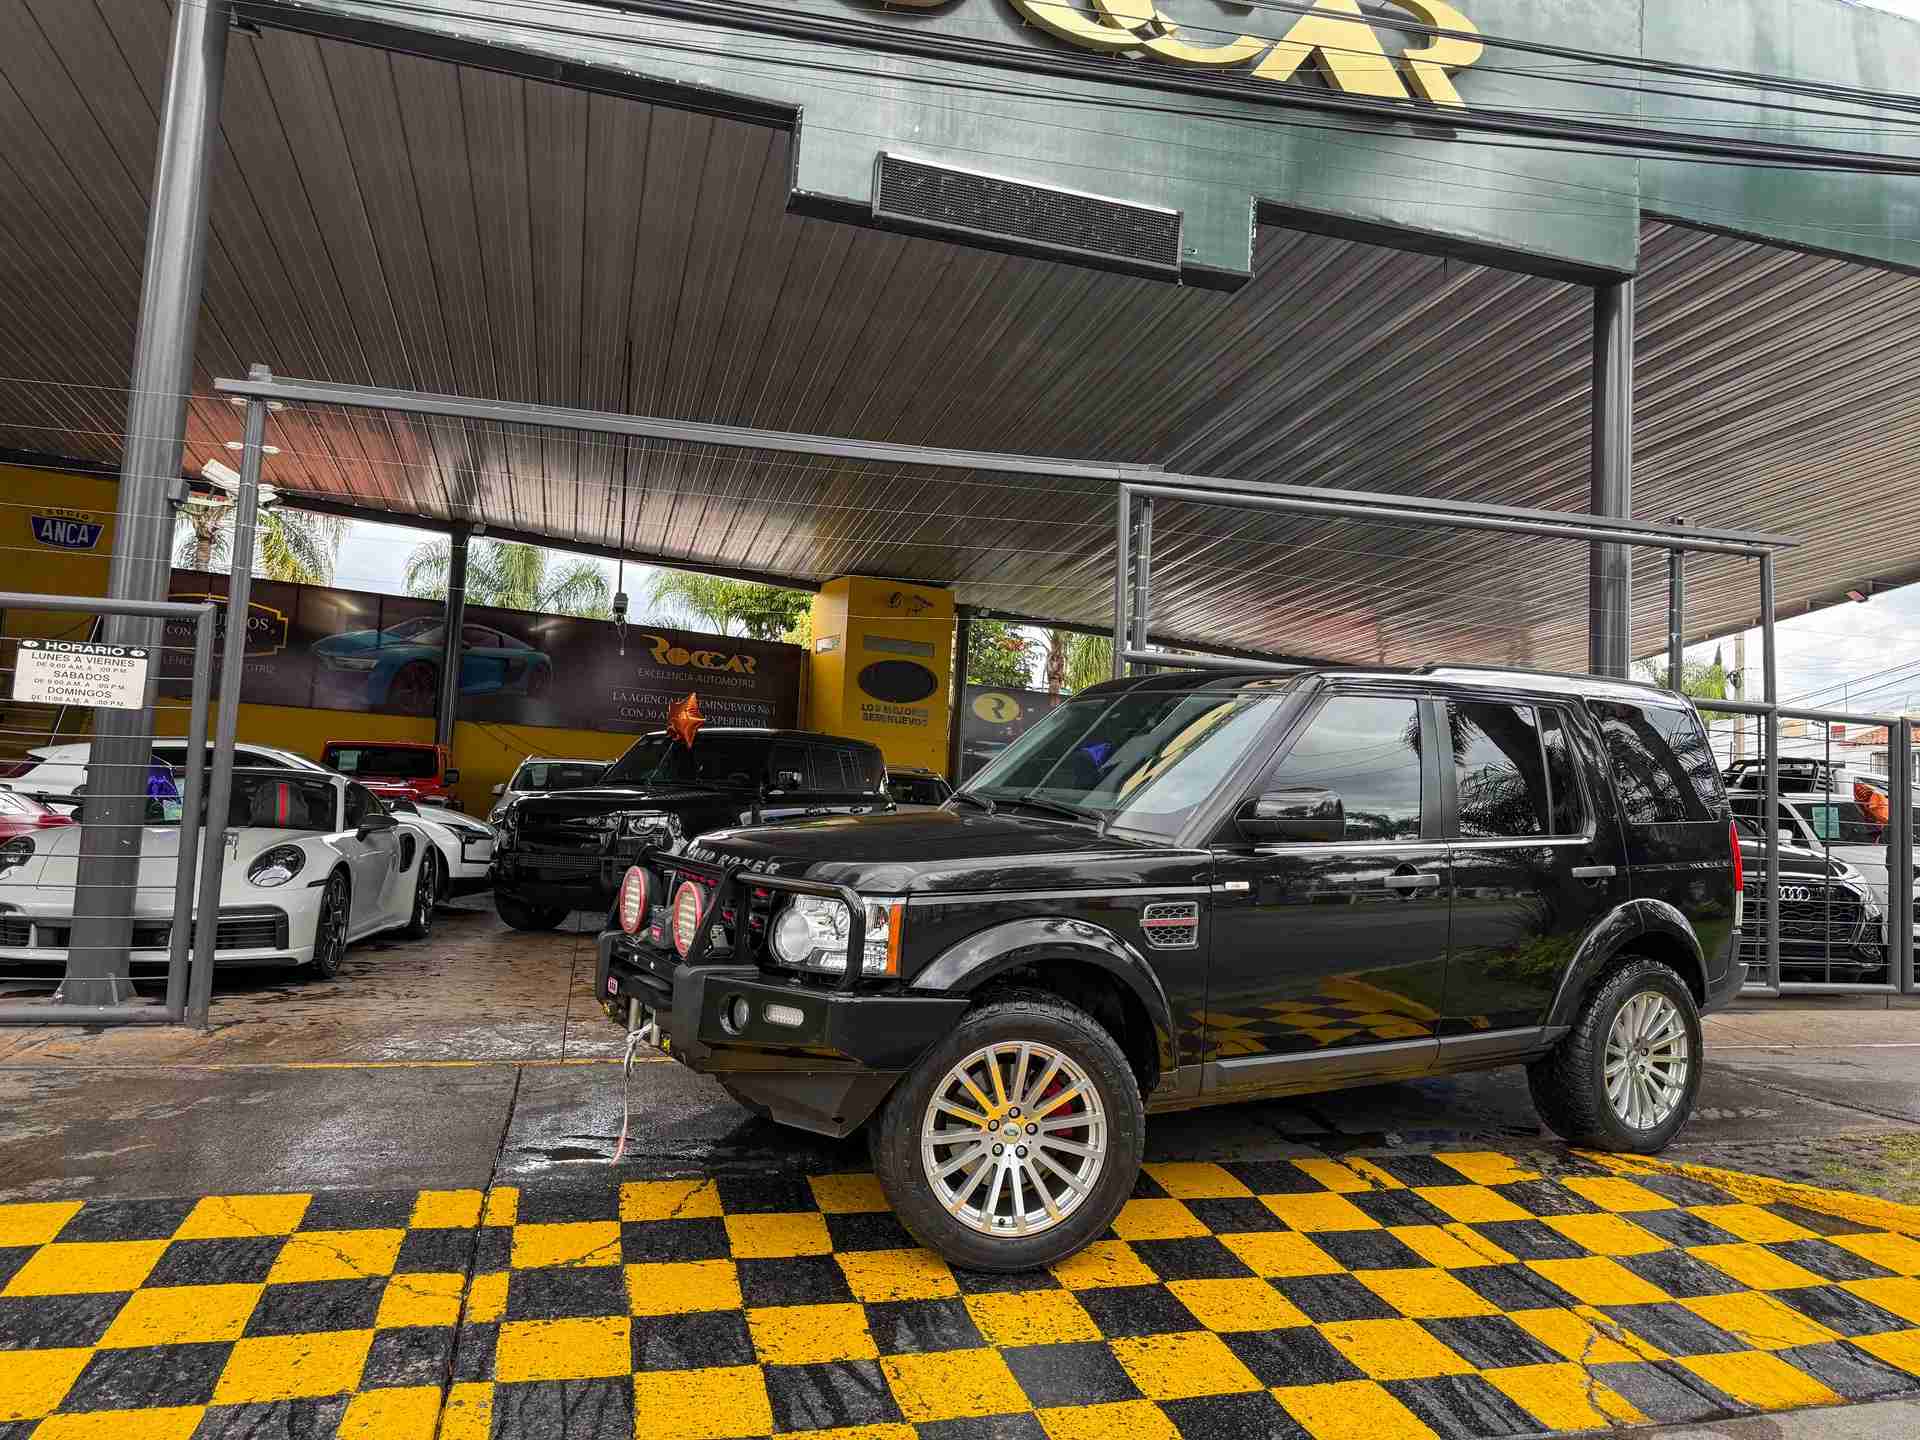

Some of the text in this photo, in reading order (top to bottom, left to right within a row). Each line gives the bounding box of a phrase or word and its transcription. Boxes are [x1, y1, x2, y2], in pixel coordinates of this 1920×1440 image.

[40, 520, 89, 544] ANCA
[45, 641, 125, 656] HORARIO
[640, 633, 758, 674] ROCCAR
[31, 651, 135, 667] LUNES A VIERNES
[53, 670, 110, 681] SABADOS
[48, 686, 112, 699] DOMINGOS
[630, 692, 674, 705] AGENCIA
[698, 700, 757, 713] EMINUEVOS
